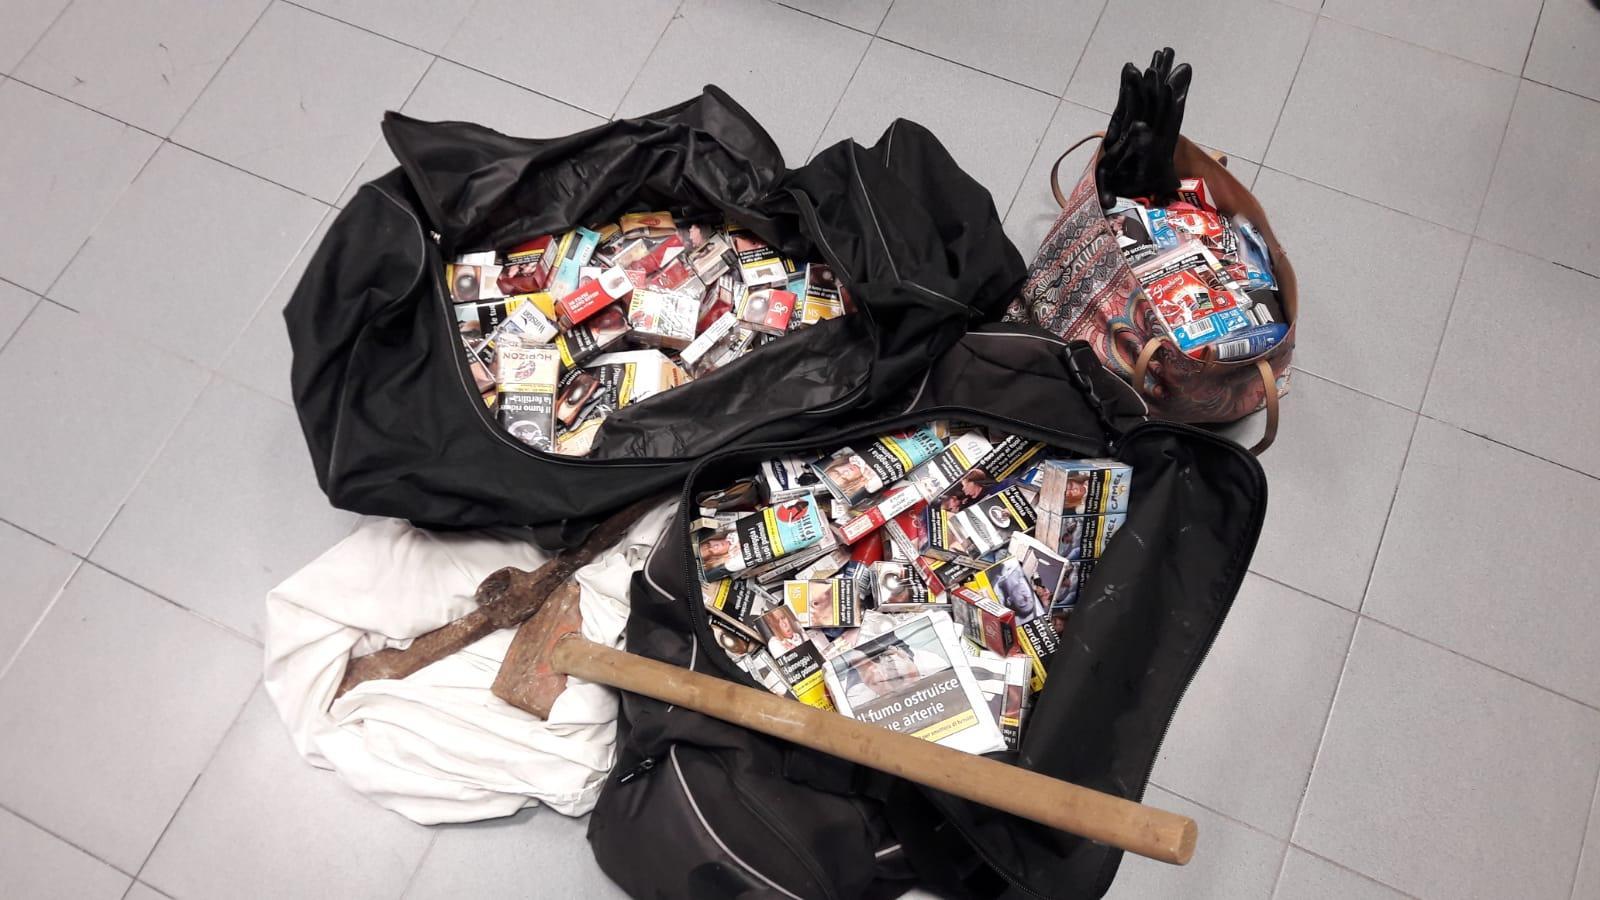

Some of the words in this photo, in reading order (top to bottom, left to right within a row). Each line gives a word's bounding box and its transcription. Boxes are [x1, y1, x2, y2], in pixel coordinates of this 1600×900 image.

[1152, 276, 1184, 298] Smoking
[523, 308, 545, 333] Winston
[876, 438, 897, 466] polmoni
[984, 452, 994, 461] tuo
[992, 441, 1007, 453] fumo
[1009, 437, 1020, 448] tuoi
[872, 447, 897, 482] danneggia
[874, 464, 888, 480] fumo
[1013, 491, 1025, 506] fumo
[1111, 474, 1122, 510] CAMEL
[1007, 495, 1026, 516] fertilità
[757, 522, 769, 544] polmoni
[808, 514, 816, 540] SPIRIT
[1104, 520, 1116, 545] MEL
[743, 543, 752, 560] fumo
[750, 530, 763, 562] danneggia
[1024, 624, 1046, 657] cardiaci
[1033, 619, 1054, 653] attacchi
[782, 652, 798, 663] fumo
[782, 656, 810, 675] danneggia
[801, 662, 818, 677] polmoni
[868, 702, 902, 722] fumo
[904, 679, 958, 706] ostruisce
[884, 721, 901, 730] ue
[903, 703, 944, 726] arterie
